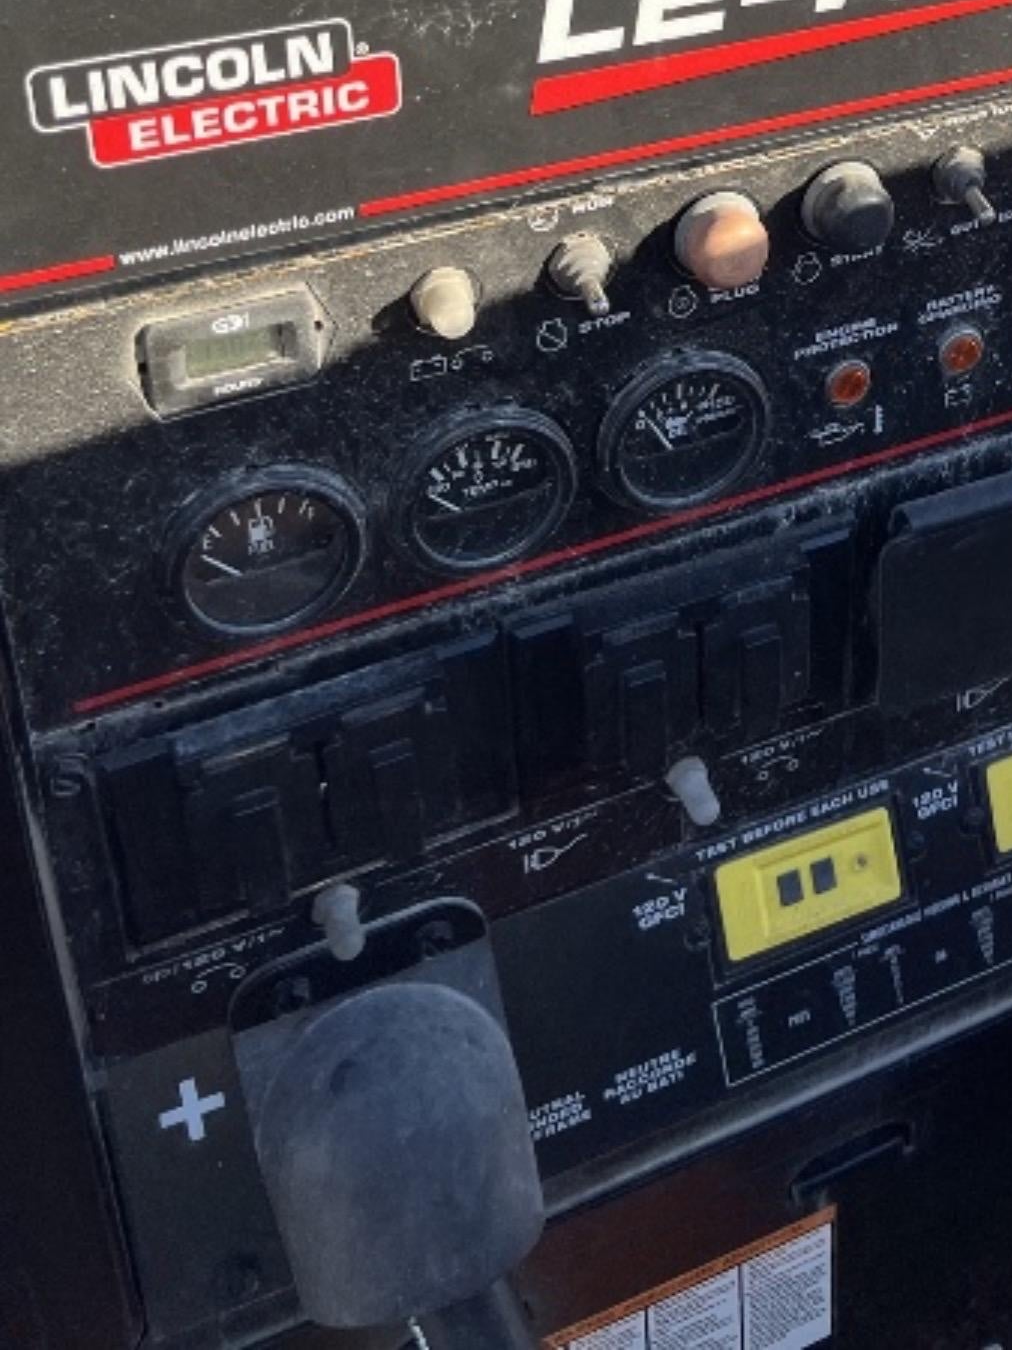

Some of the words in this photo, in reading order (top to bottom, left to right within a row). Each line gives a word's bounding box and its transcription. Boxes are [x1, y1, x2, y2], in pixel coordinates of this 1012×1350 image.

[49, 30, 336, 121] LINCOLN
[128, 79, 370, 152] ELECTRIC
[117, 203, 357, 267] www.lincolnelectric.com
[710, 283, 761, 304] PLUG
[578, 310, 633, 334] STOP
[695, 837, 737, 862] TEST
[742, 813, 807, 845] BEFORE
[809, 791, 855, 818] EACH
[856, 778, 891, 800] USE
[632, 896, 669, 917] 120
[671, 886, 688, 902] V
[638, 901, 686, 931] GFCI
[614, 1048, 681, 1084] NEUTRE
[530, 1090, 586, 1120] UTRAL
